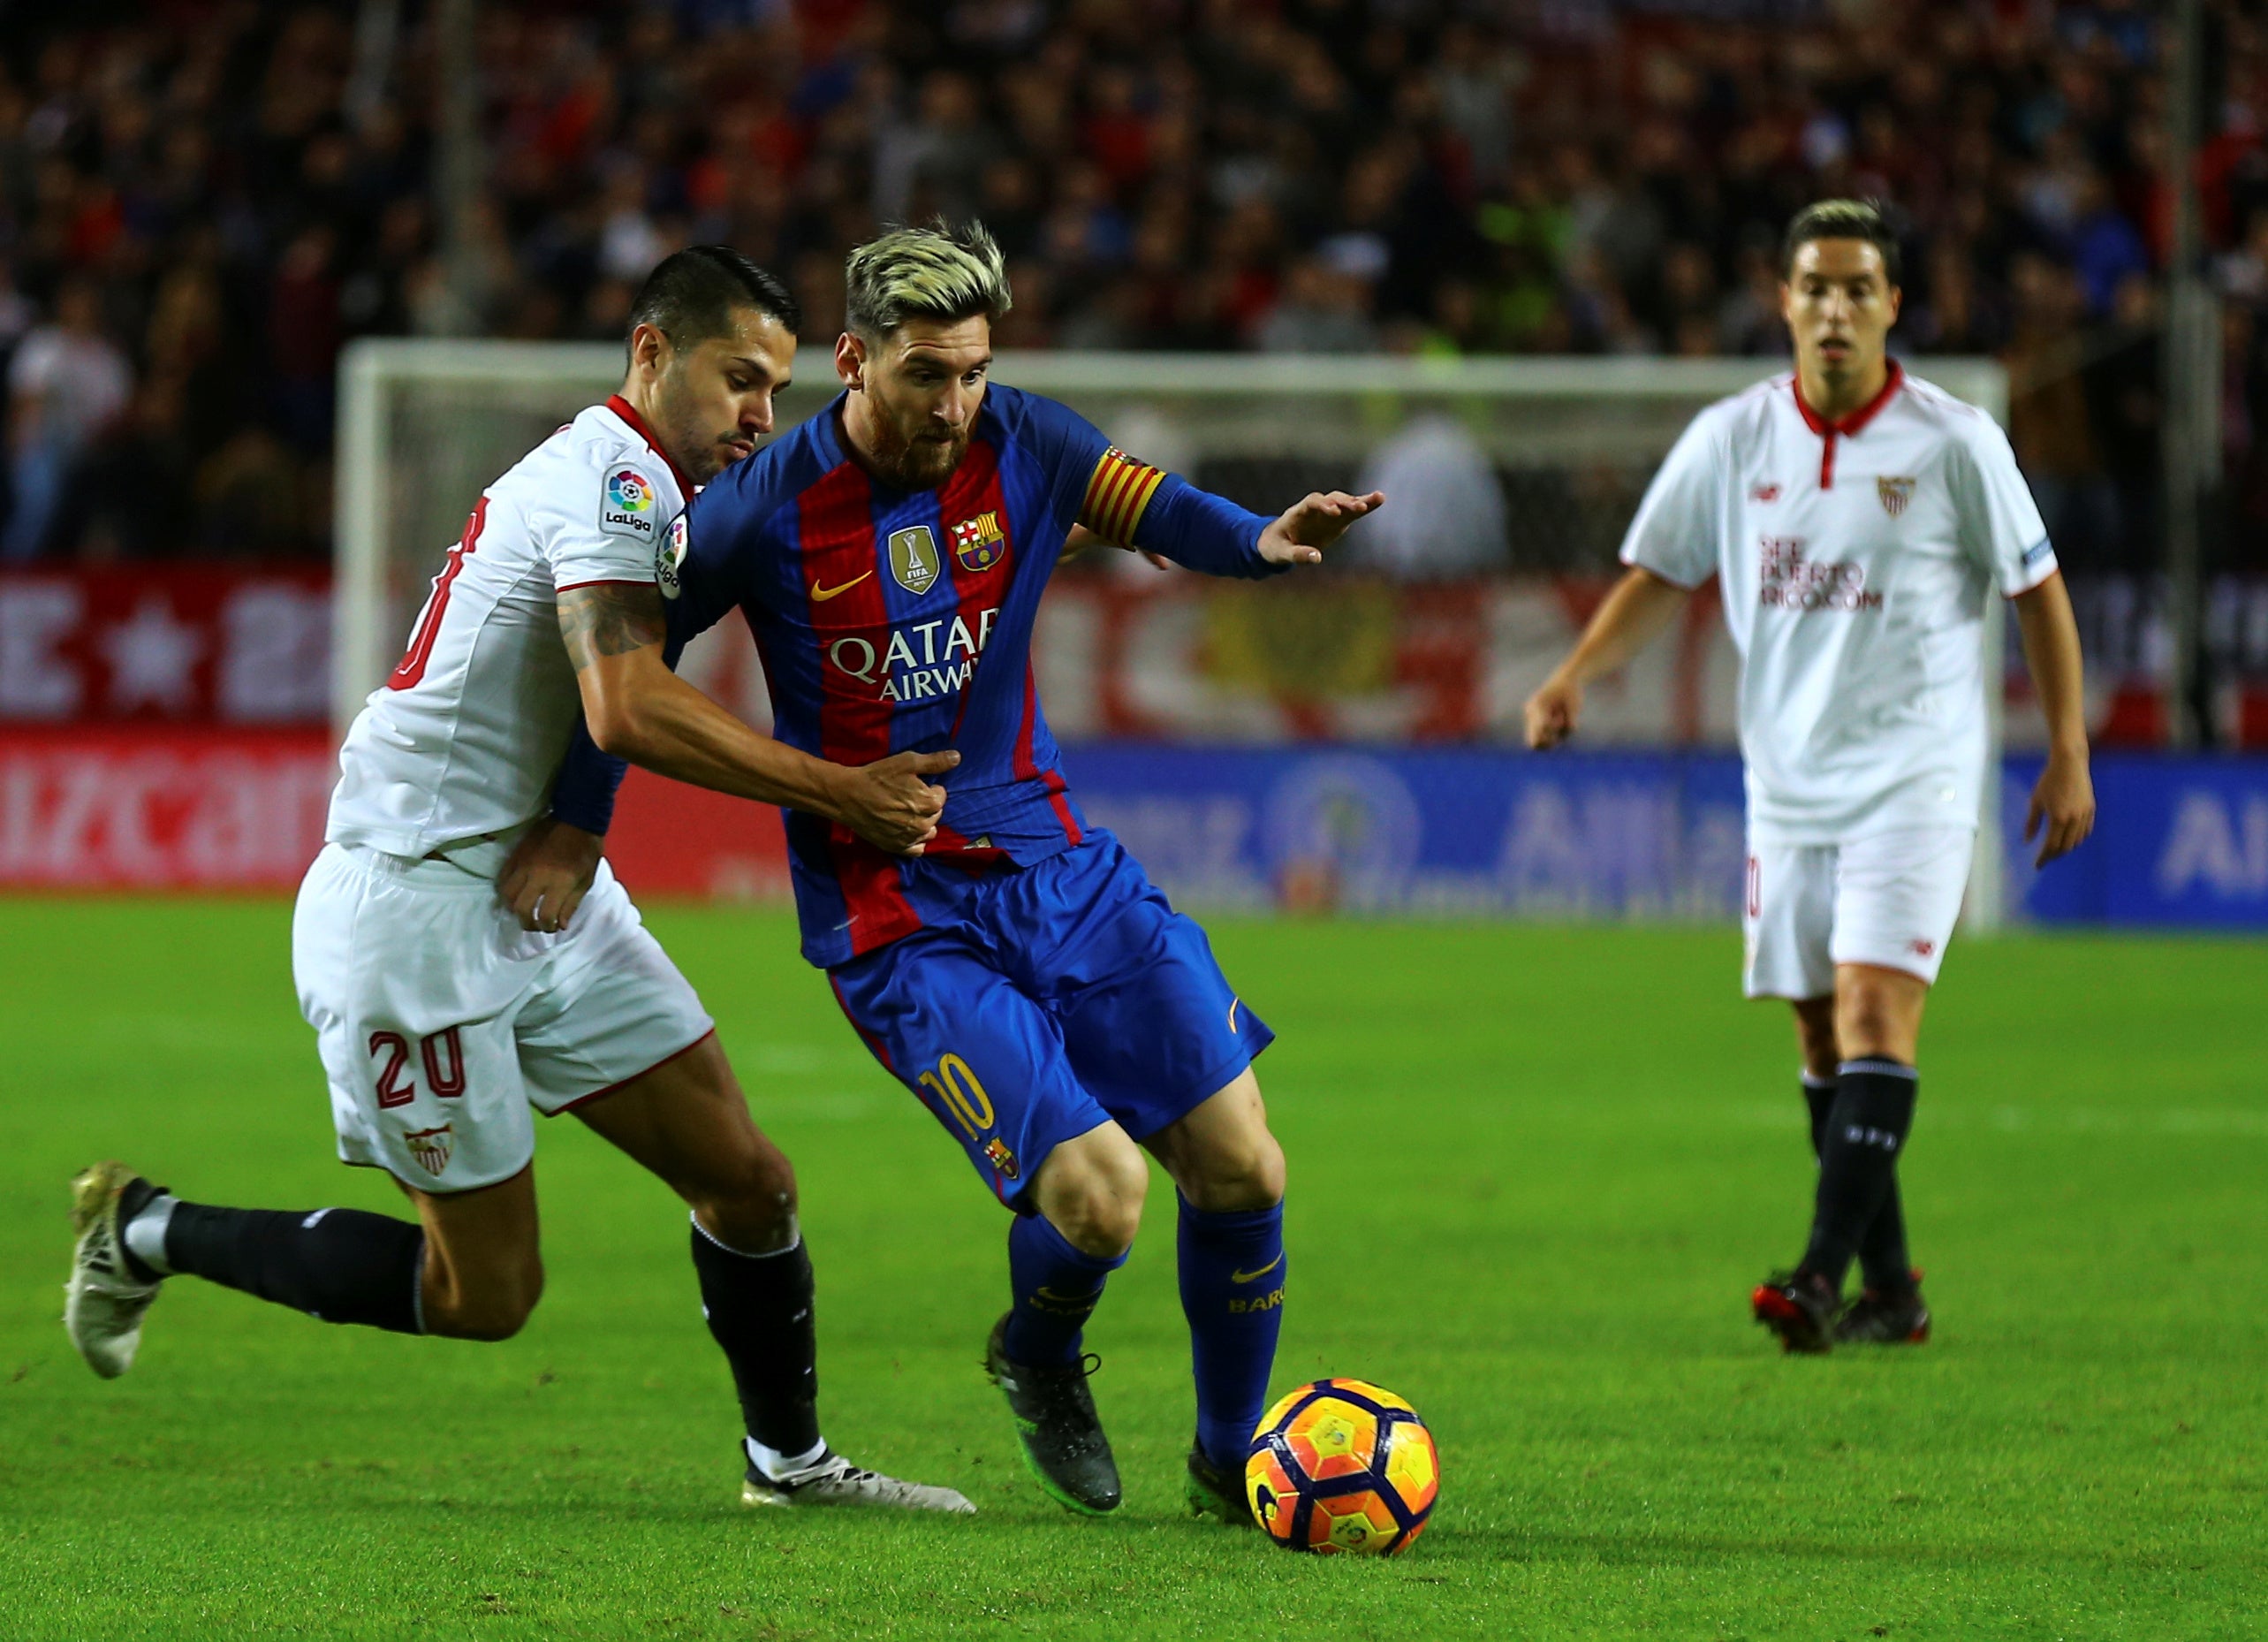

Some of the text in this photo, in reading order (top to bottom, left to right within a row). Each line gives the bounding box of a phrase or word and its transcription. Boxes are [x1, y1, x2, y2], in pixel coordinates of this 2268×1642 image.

[606, 512, 651, 531] LaLiga
[655, 559, 679, 588] aLiga
[907, 567, 928, 579] FIFA
[879, 658, 979, 702] AIRWA
[368, 1024, 466, 1109] 20
[918, 1053, 995, 1141] 10
